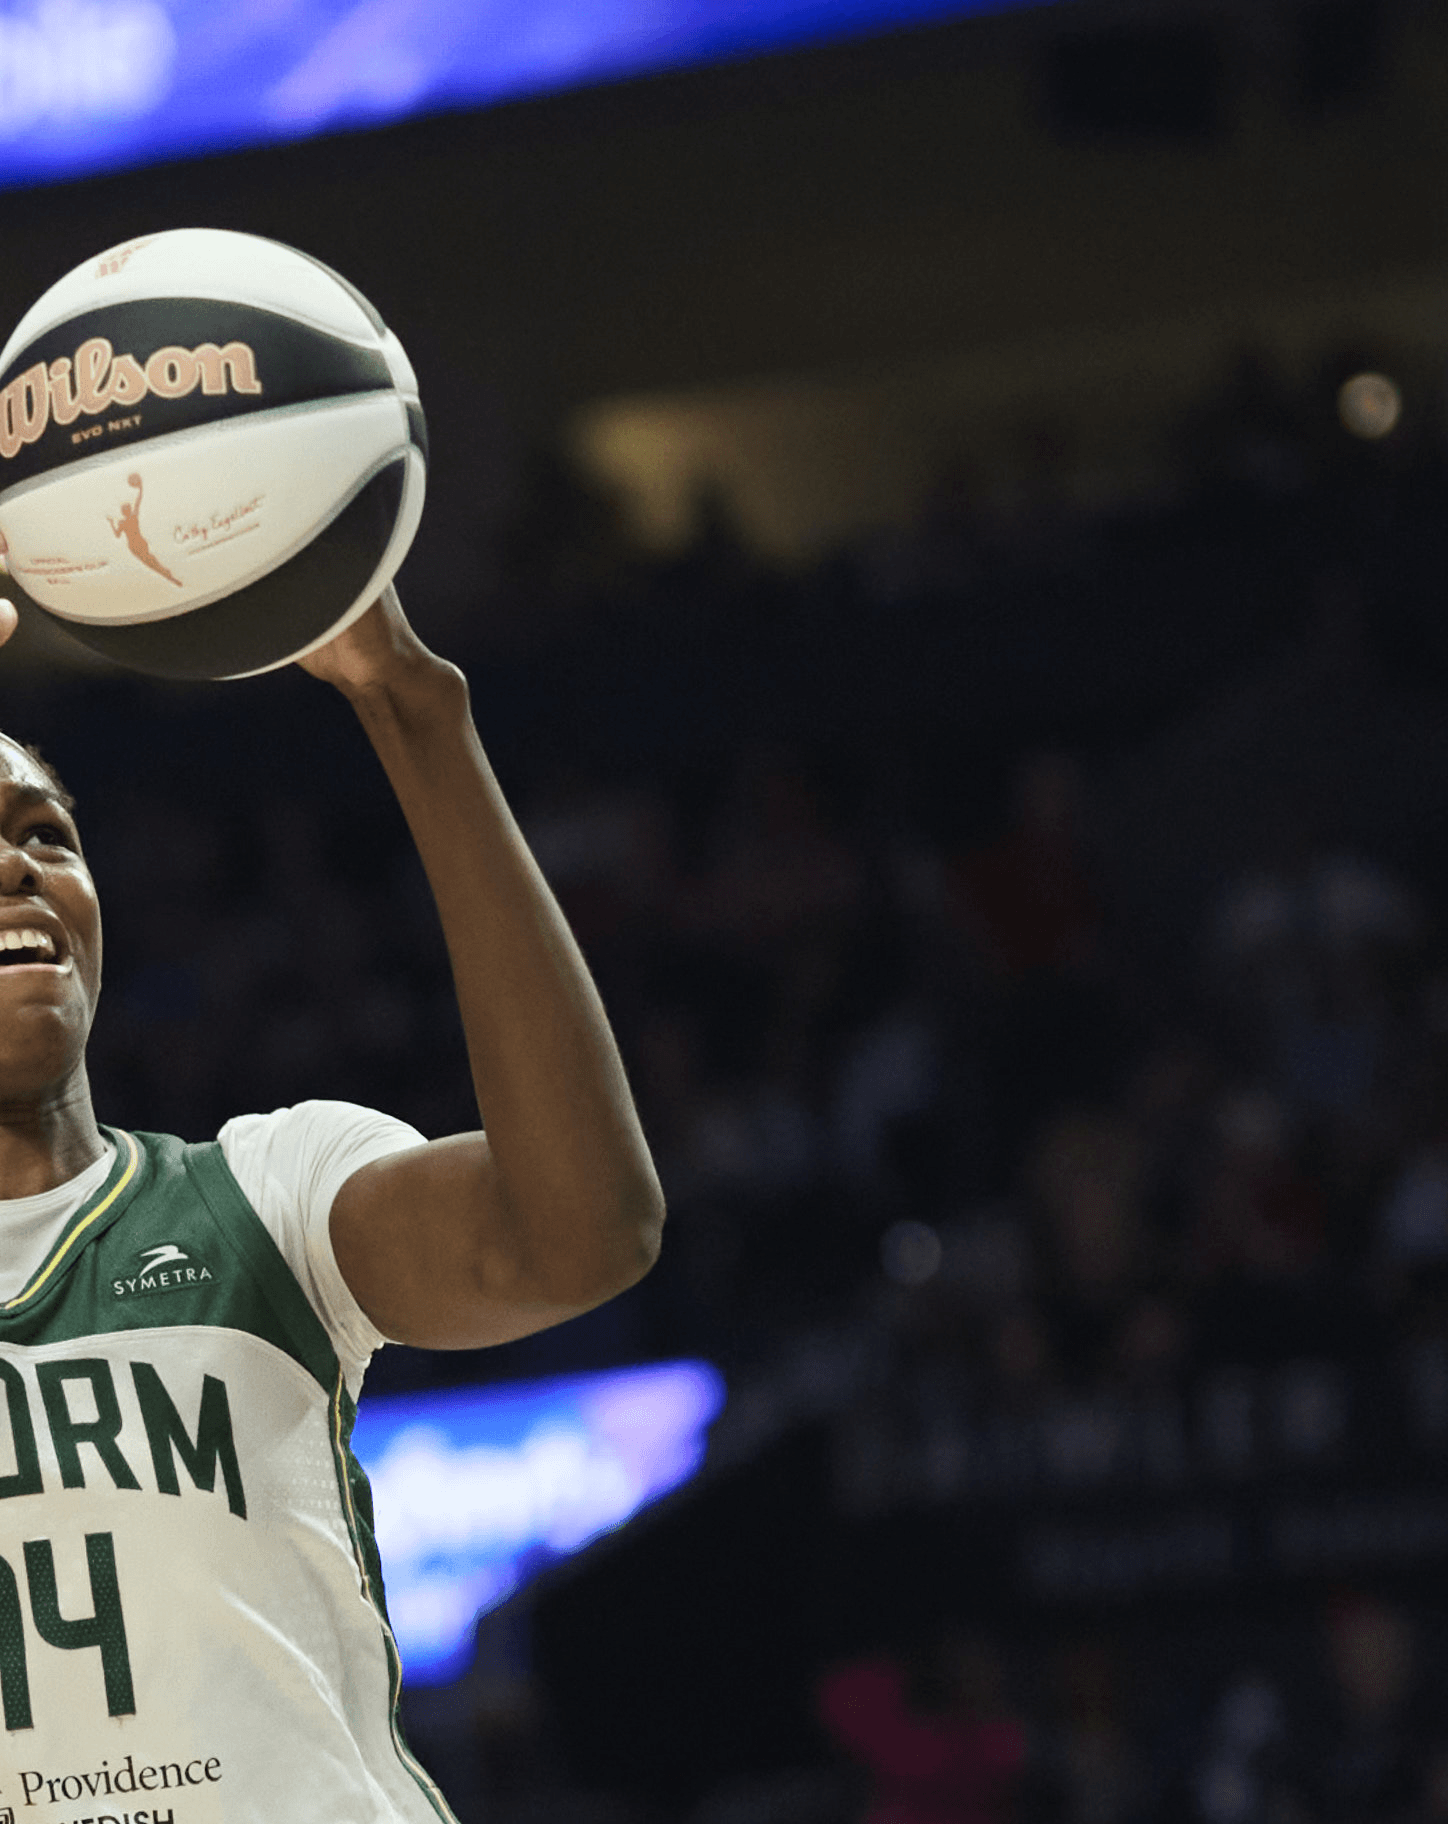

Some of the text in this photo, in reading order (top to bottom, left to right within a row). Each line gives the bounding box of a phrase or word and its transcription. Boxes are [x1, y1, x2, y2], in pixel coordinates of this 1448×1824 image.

[71, 414, 142, 444] EVO NXT
[113, 1267, 212, 1295] SYMETRA
[18, 1755, 222, 1806] Providence
